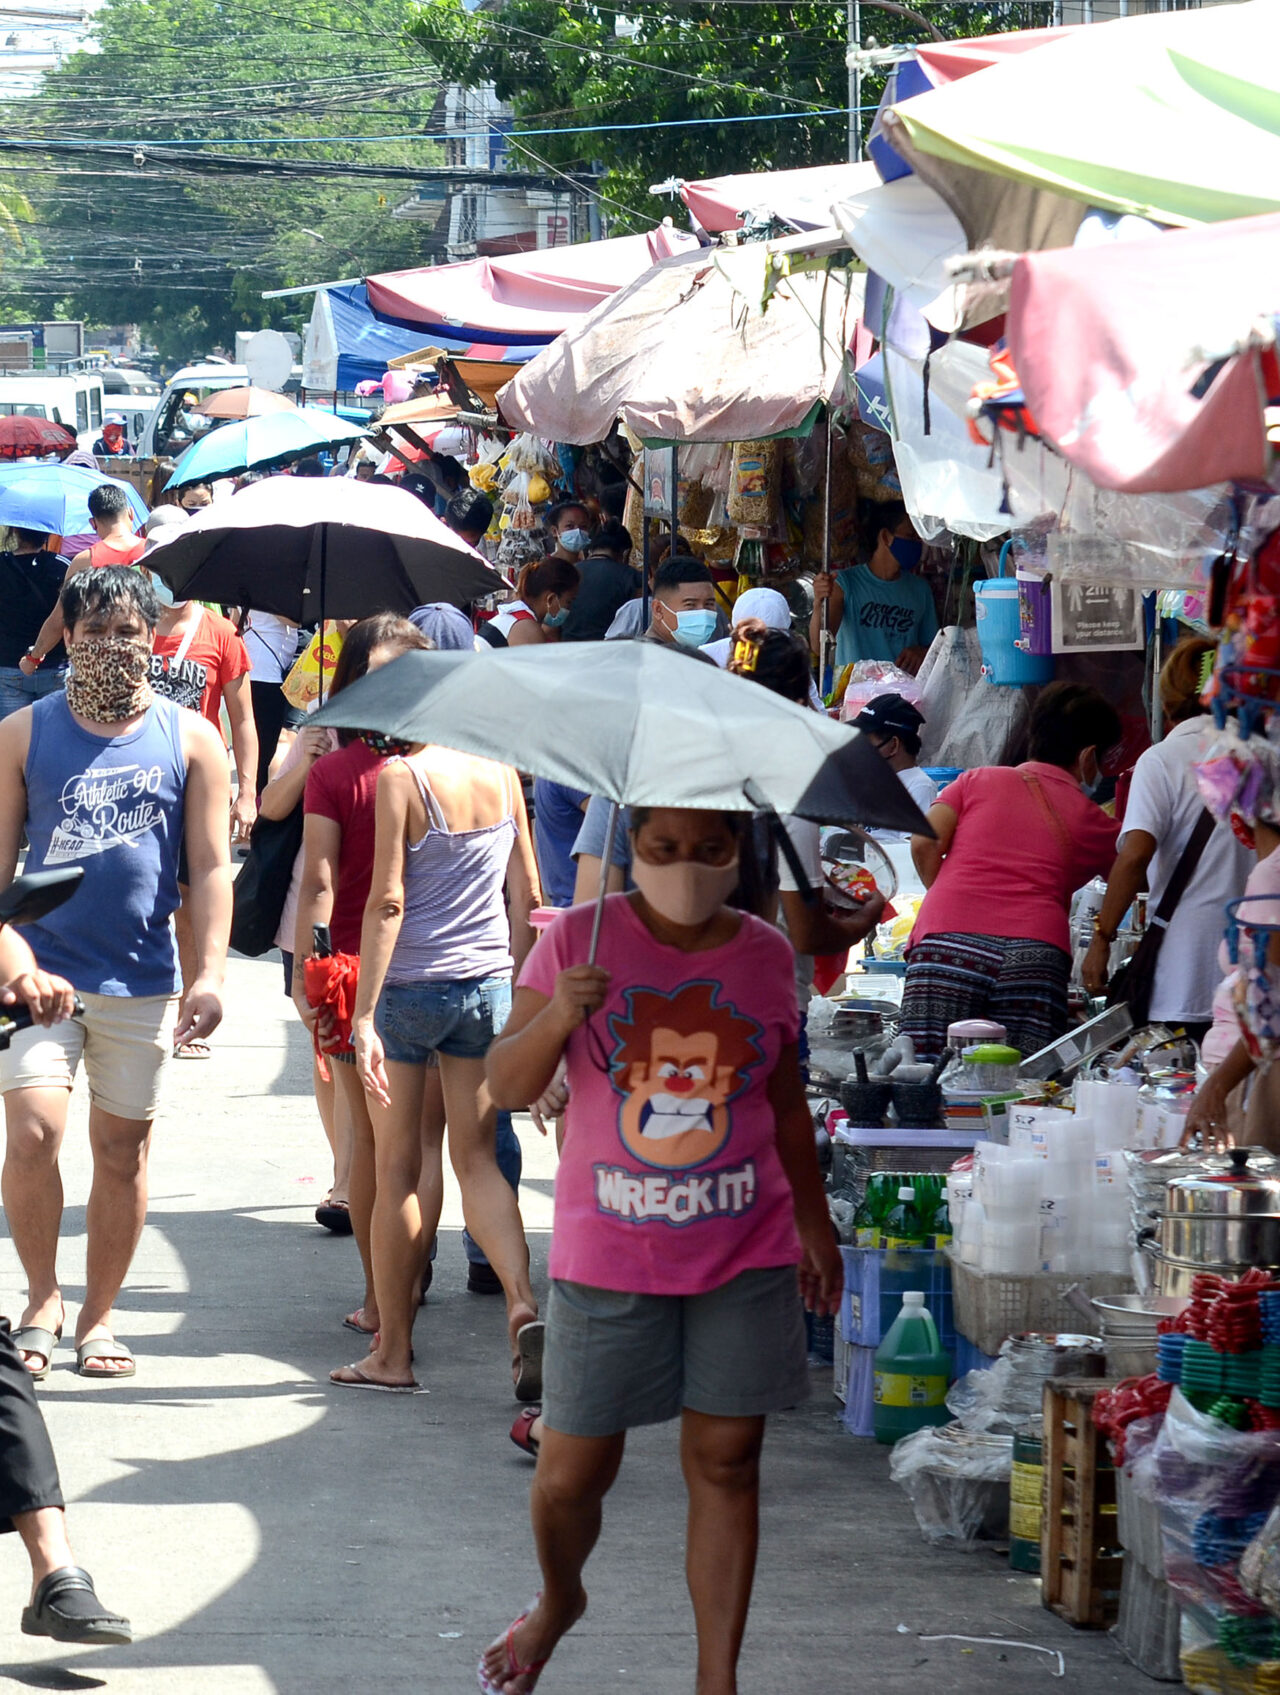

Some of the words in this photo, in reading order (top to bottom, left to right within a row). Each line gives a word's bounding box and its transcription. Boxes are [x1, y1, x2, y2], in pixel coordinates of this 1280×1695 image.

[1076, 630, 1092, 639] your
[1093, 629, 1124, 637] distance
[1077, 621, 1101, 629] Please
[1102, 620, 1121, 629] keep
[63, 777, 129, 814] Athletic
[133, 765, 162, 798] 90
[92, 799, 157, 848] Route
[596, 1167, 715, 1223] WRECK
[718, 1163, 756, 1213] IT!
